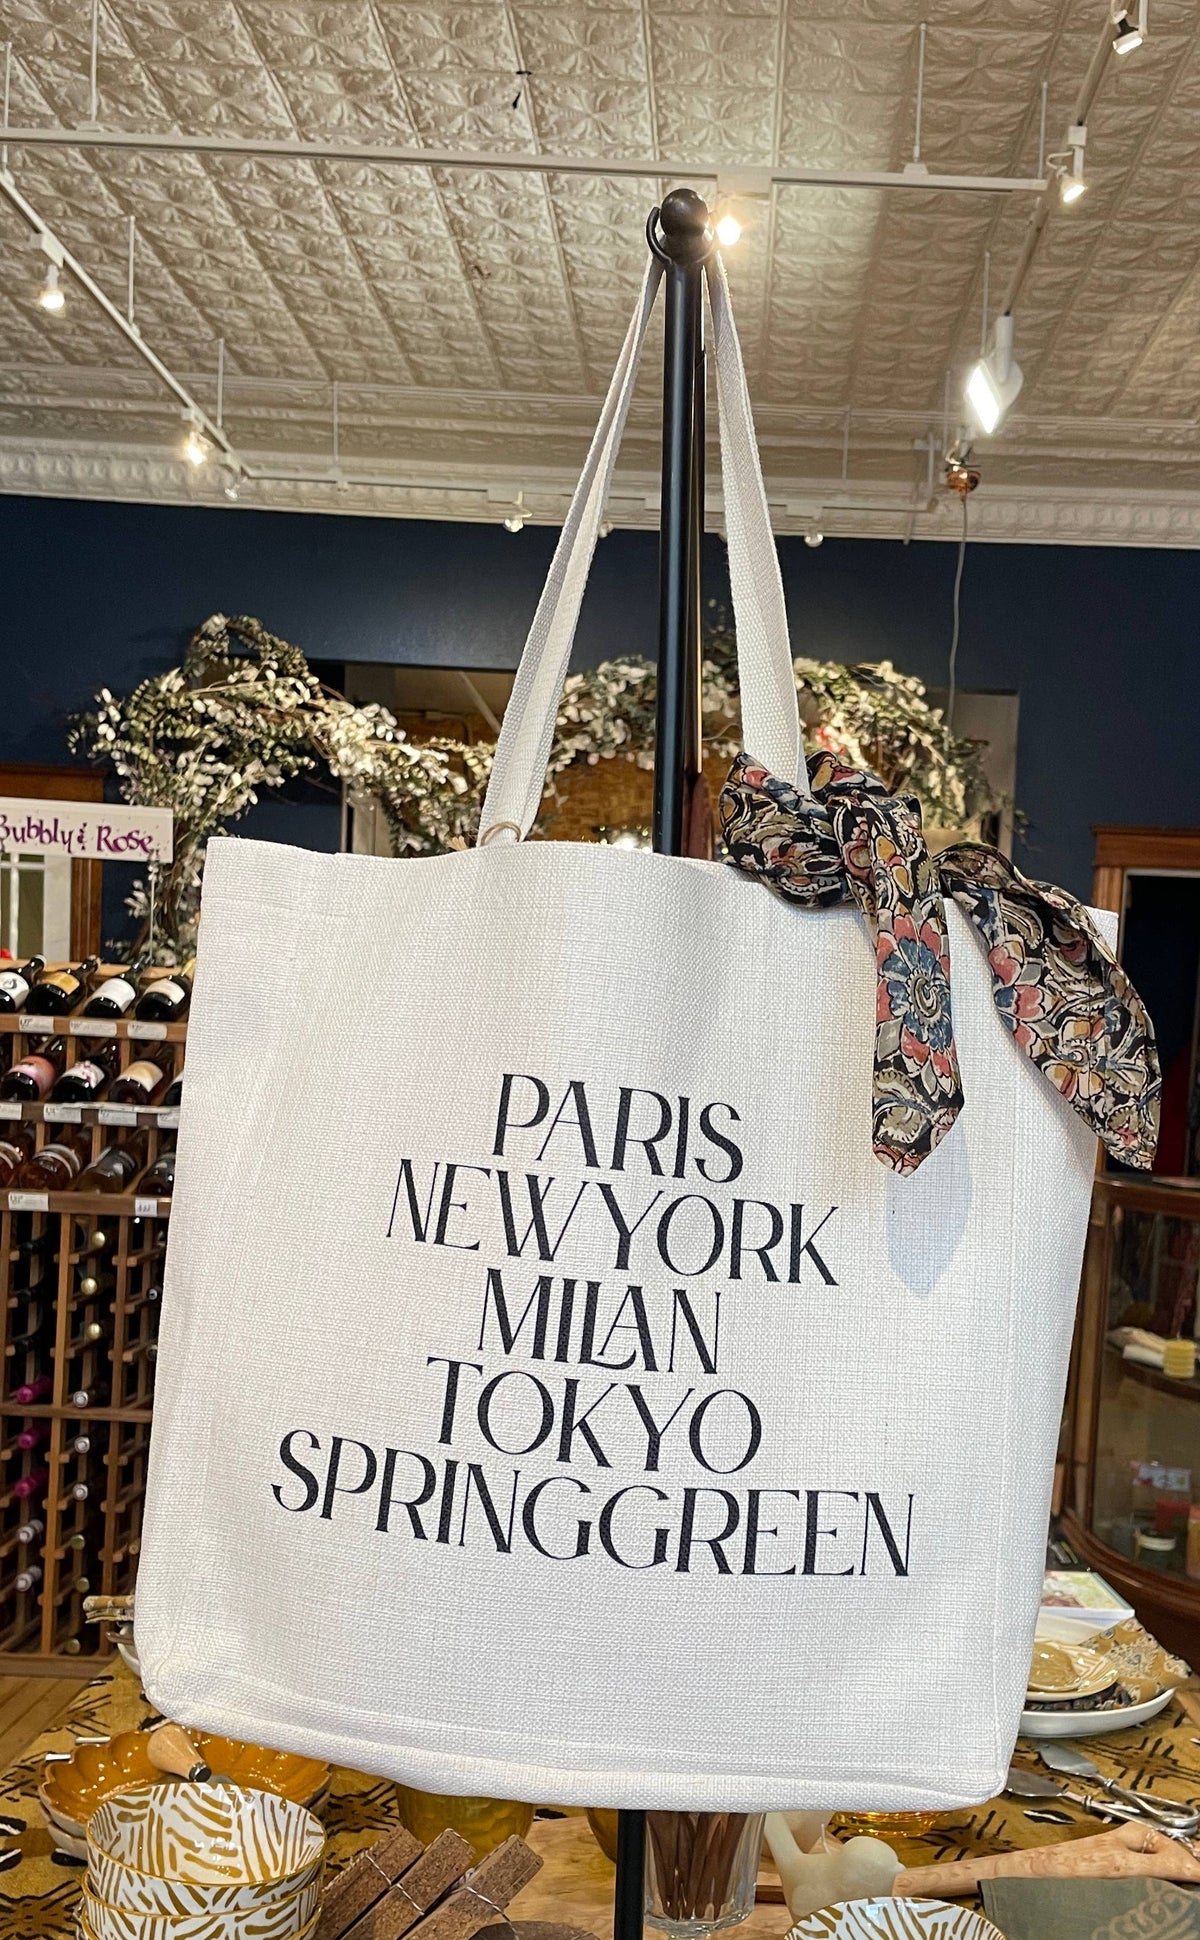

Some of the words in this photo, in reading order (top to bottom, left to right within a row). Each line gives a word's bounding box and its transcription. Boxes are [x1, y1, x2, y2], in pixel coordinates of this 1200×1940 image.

[493, 1074, 743, 1183] PARIS
[478, 1268, 721, 1374] MILAN
[427, 1357, 761, 1474] TOKYO
